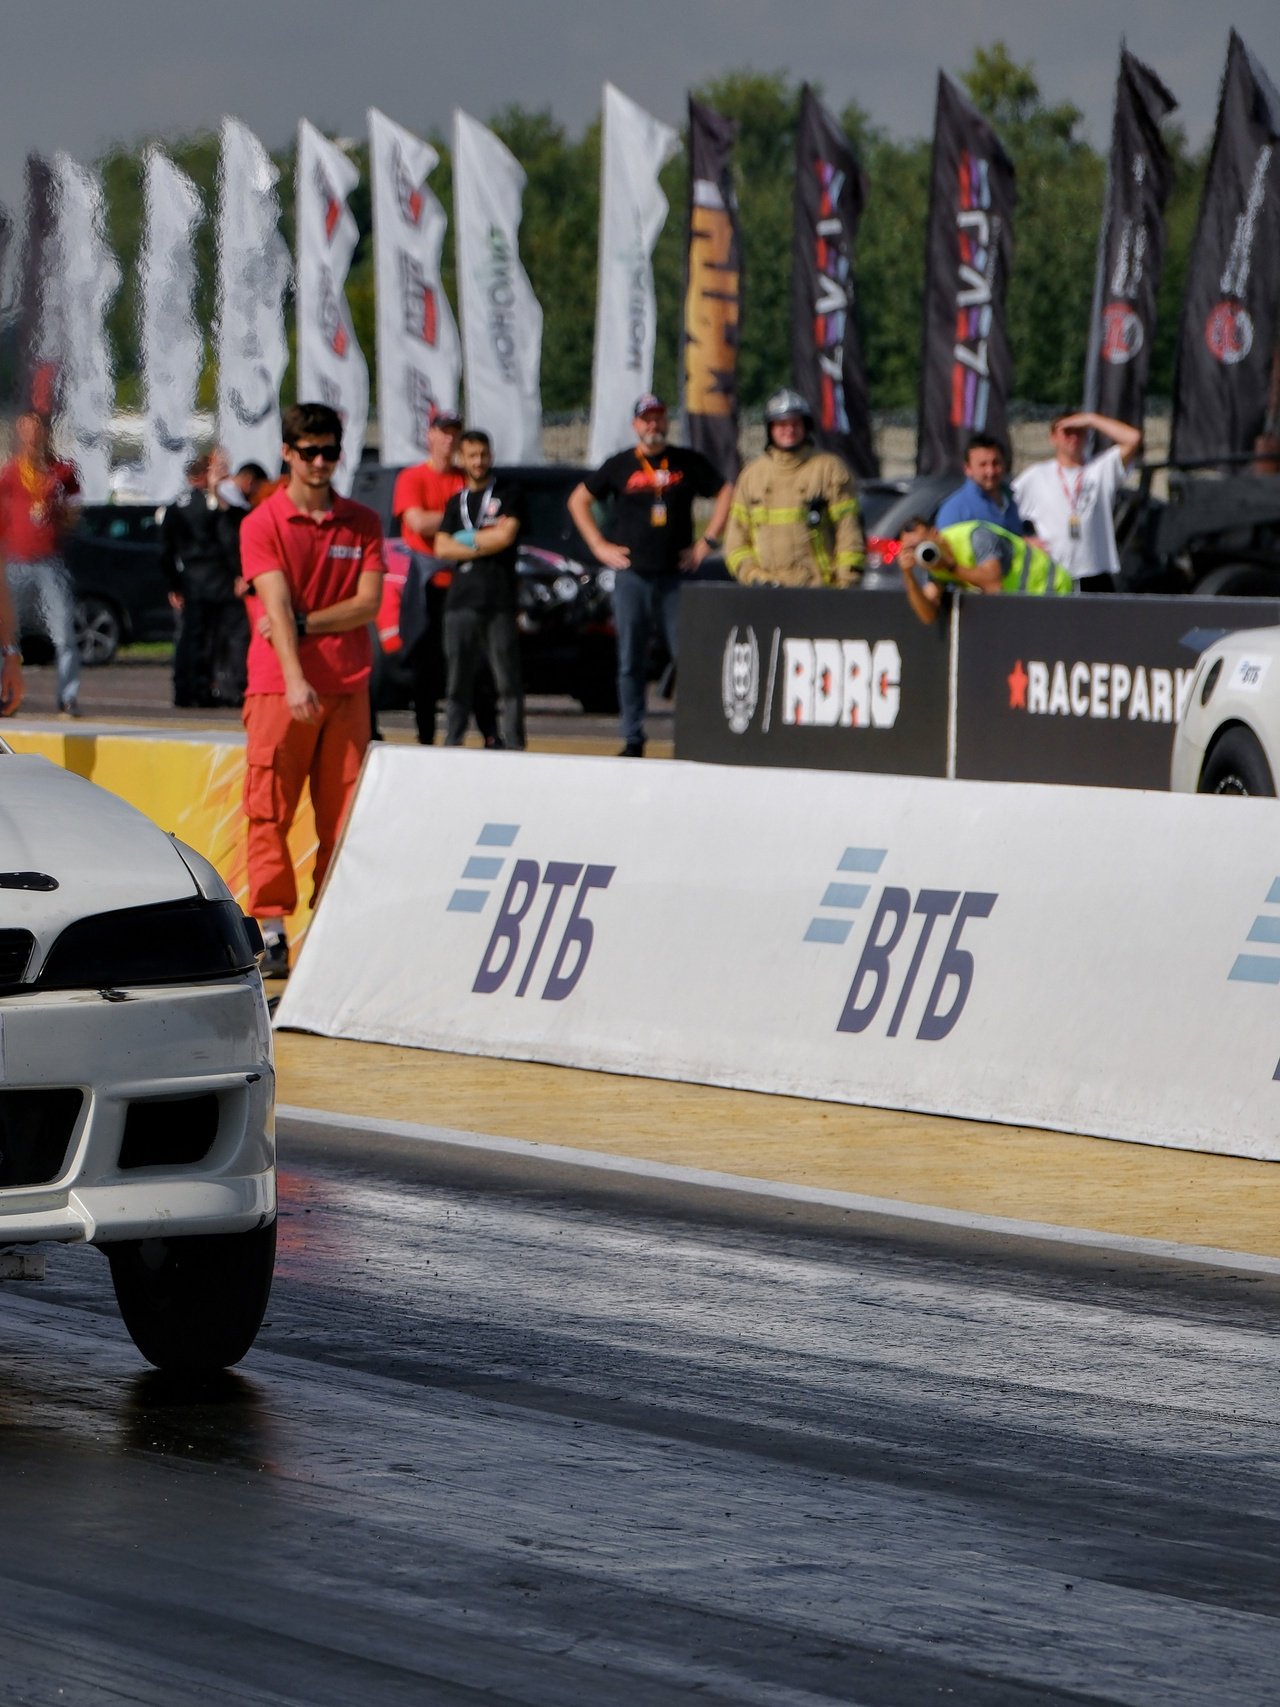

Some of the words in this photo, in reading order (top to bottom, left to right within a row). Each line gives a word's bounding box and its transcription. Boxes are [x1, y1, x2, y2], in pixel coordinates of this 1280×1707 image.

[782, 637, 902, 729] RDRC
[1027, 660, 1196, 724] RACEPARK
[472, 859, 617, 1001] ВТБ
[836, 886, 999, 1041] ВТБ
